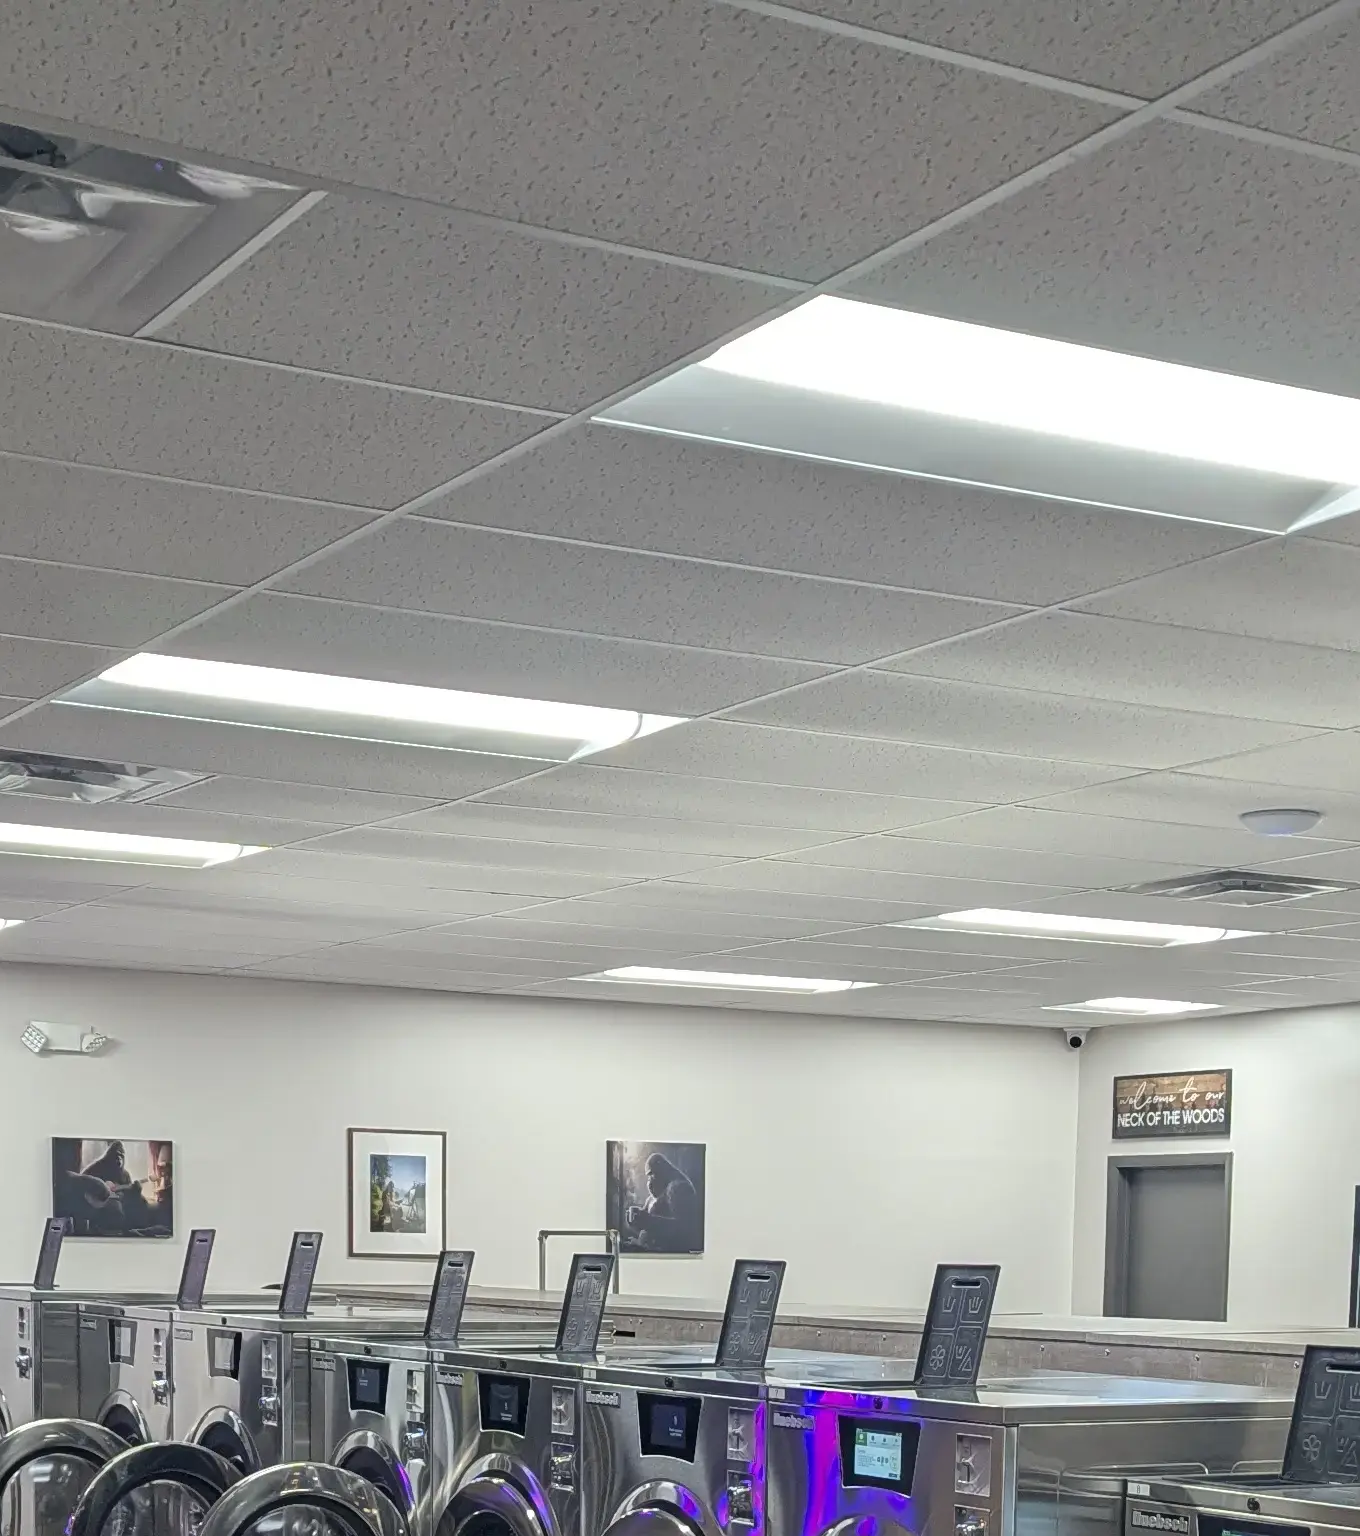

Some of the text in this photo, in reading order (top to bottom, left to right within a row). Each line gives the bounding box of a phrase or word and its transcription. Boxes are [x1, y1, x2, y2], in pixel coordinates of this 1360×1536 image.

[1119, 1076, 1226, 1110] welcome to our
[1117, 1107, 1225, 1128] NECK OF THE WOODS
